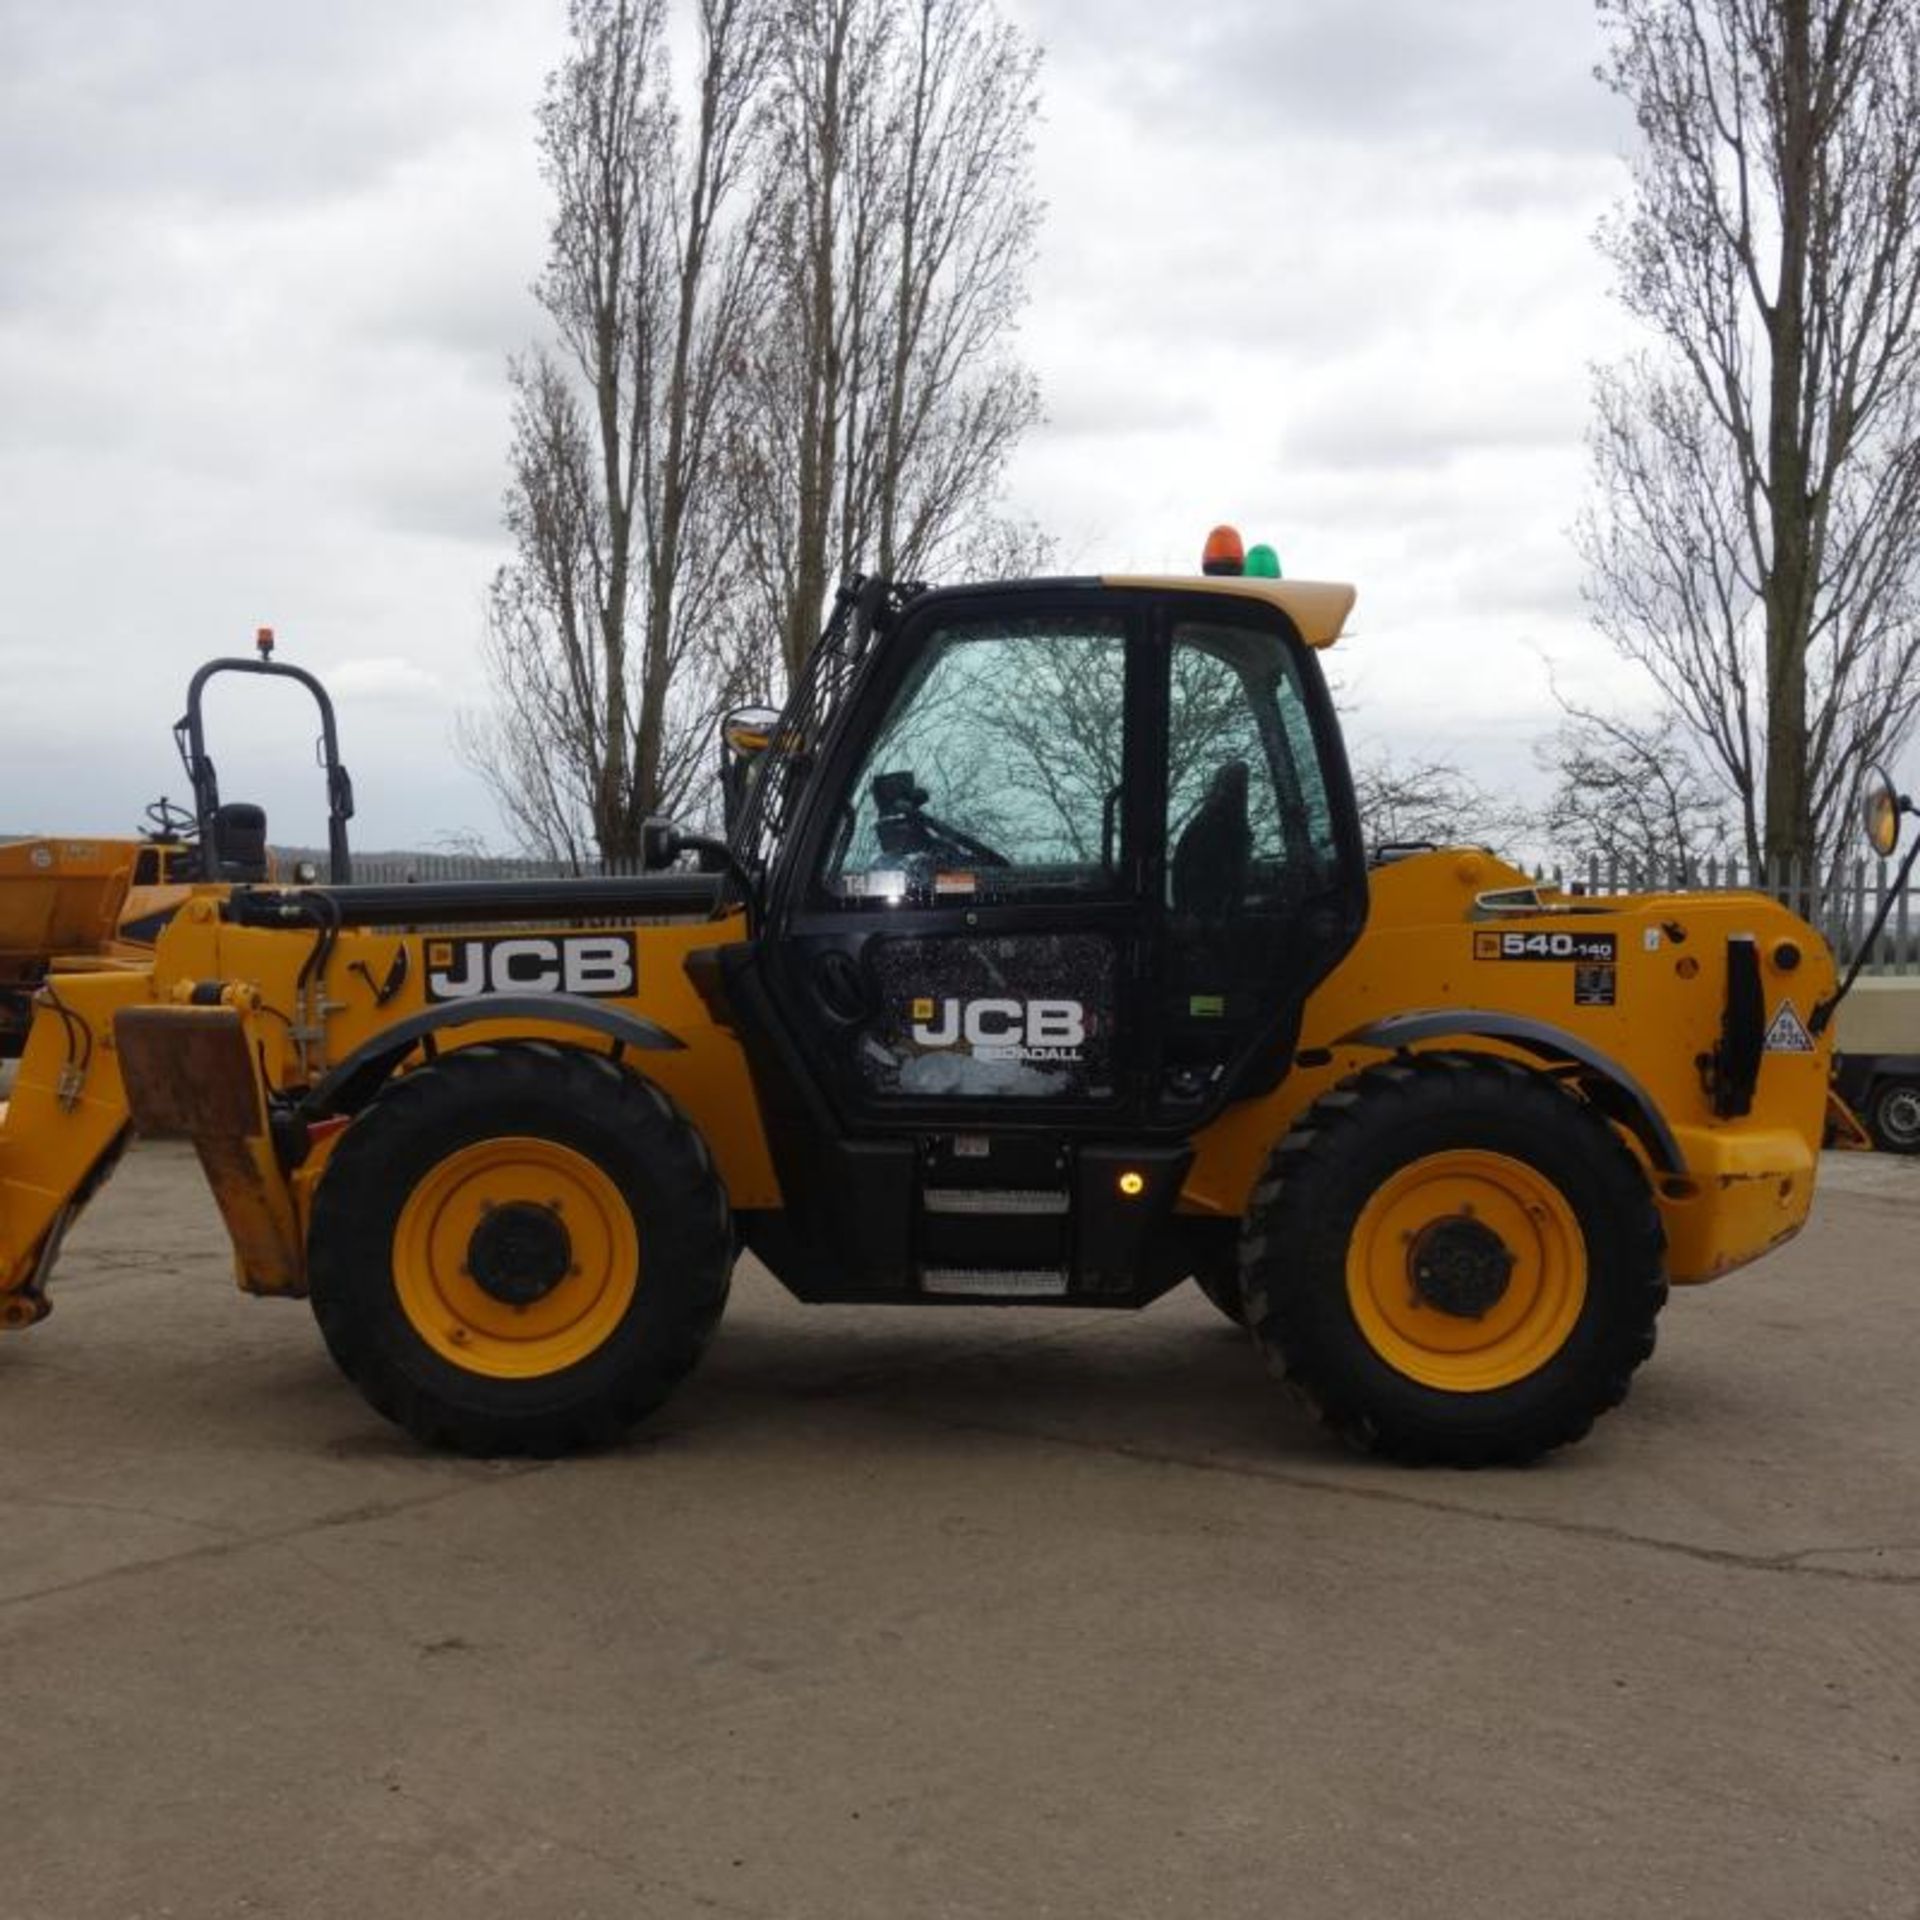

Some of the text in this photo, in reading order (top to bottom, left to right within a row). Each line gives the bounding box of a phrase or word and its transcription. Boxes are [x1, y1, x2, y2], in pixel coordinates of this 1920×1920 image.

[430, 938, 633, 997] JCB
[1503, 932, 1612, 957] 540-140
[912, 998, 1085, 1047] JCB
